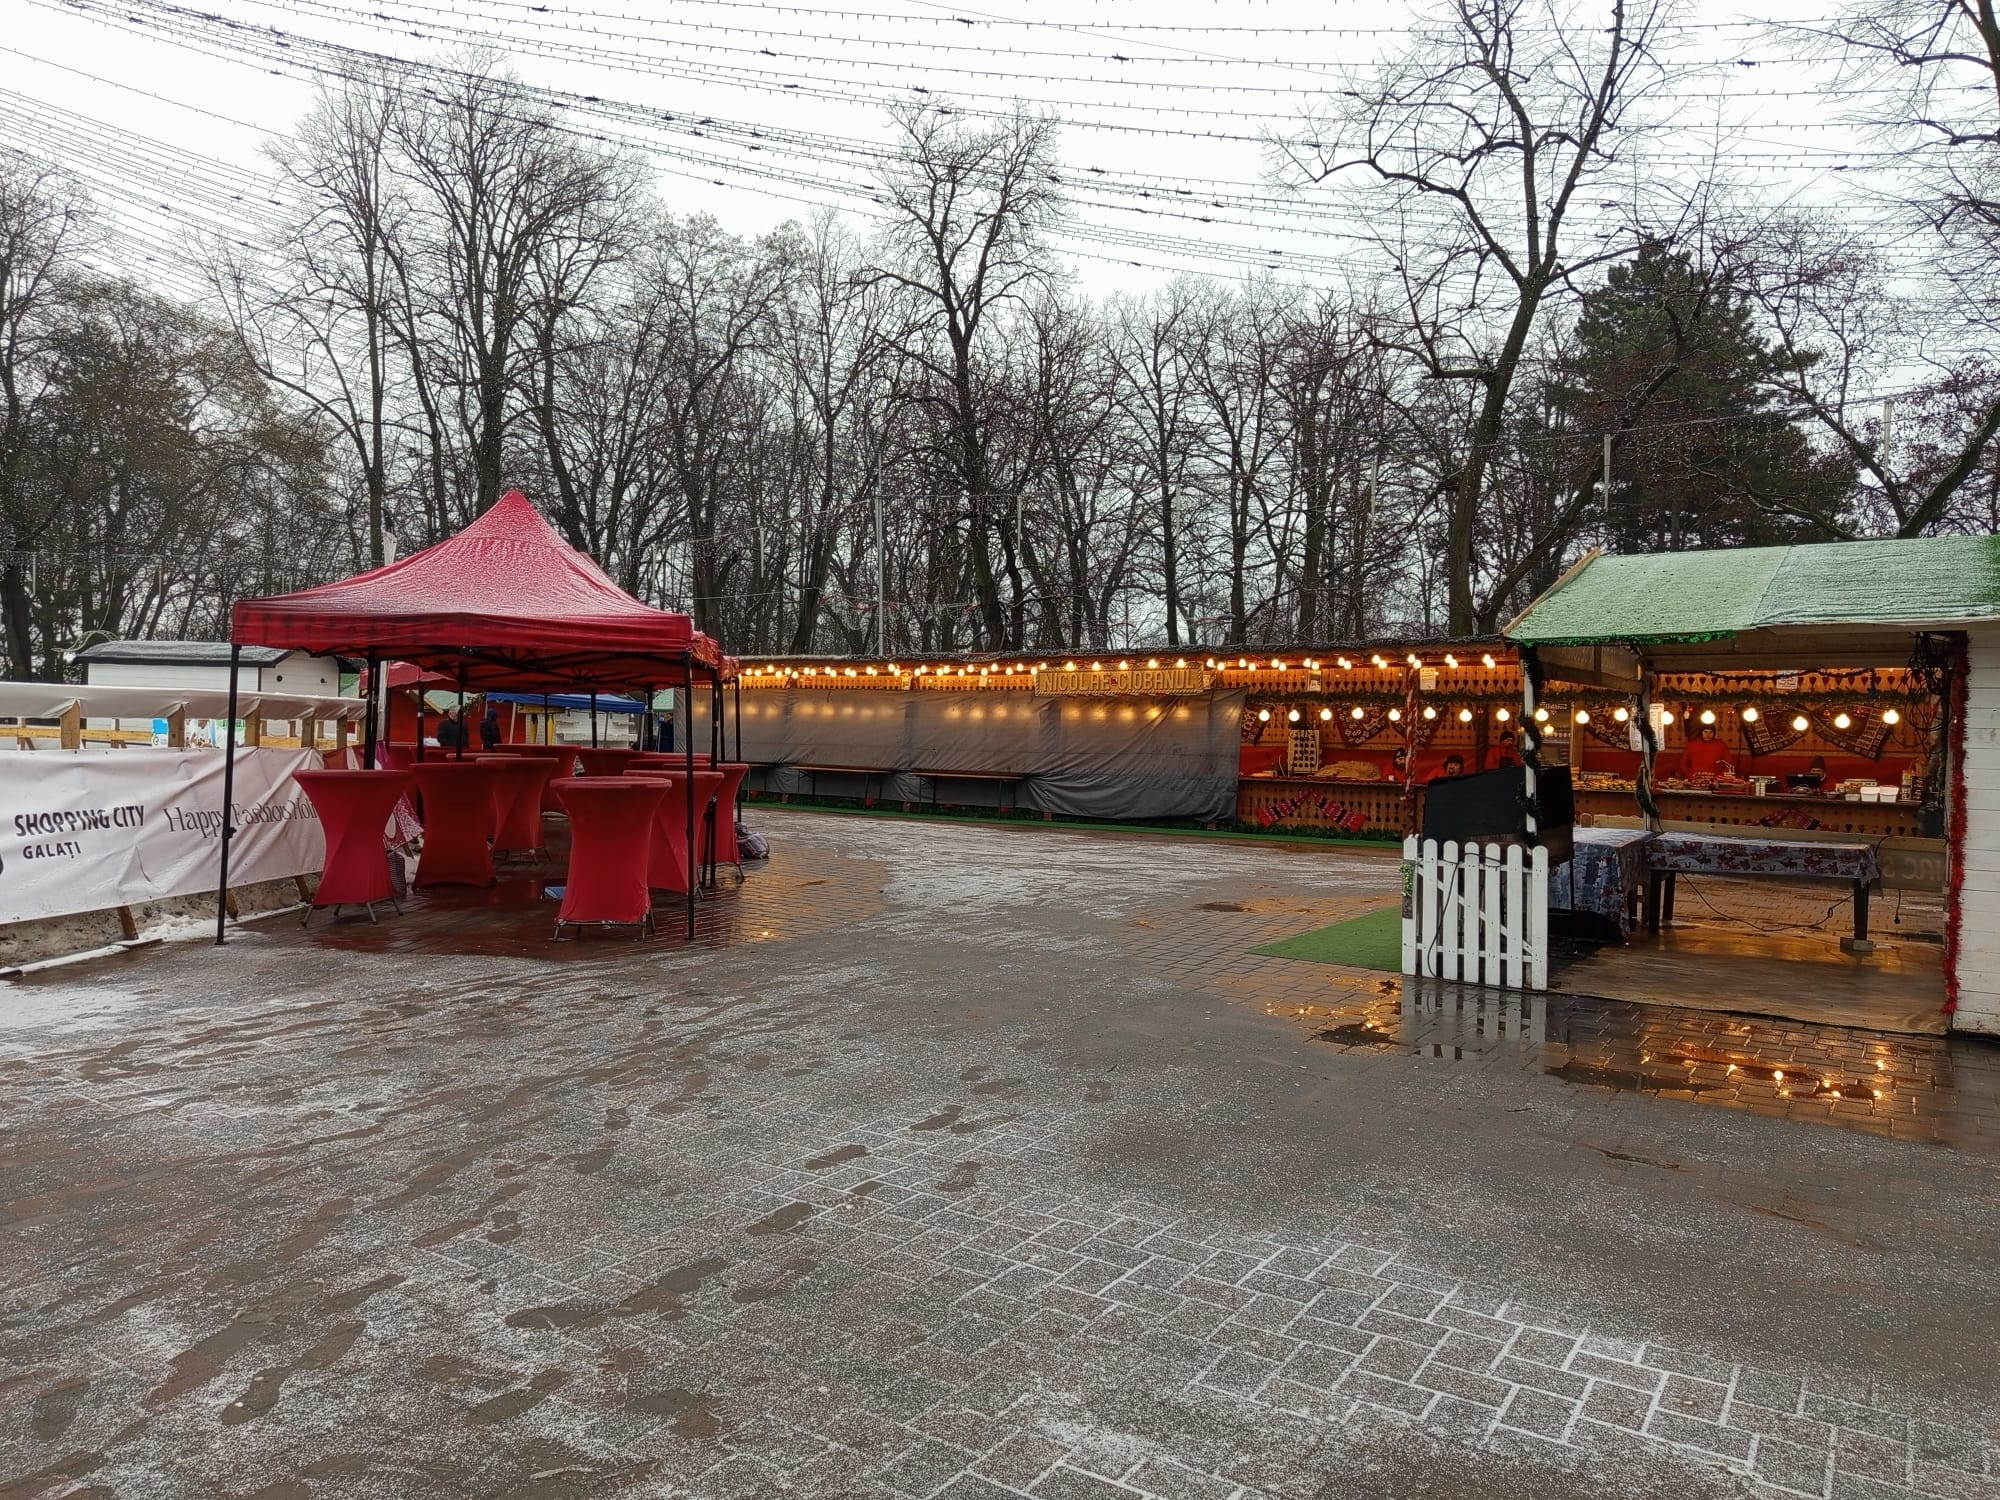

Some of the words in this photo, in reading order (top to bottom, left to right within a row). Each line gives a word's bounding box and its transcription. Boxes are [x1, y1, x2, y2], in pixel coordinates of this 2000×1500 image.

[1042, 671, 1111, 691] NICOLAE
[1118, 669, 1195, 690] CIOBANUL
[14, 808, 111, 837] SHOPPING
[113, 805, 145, 828] CITY
